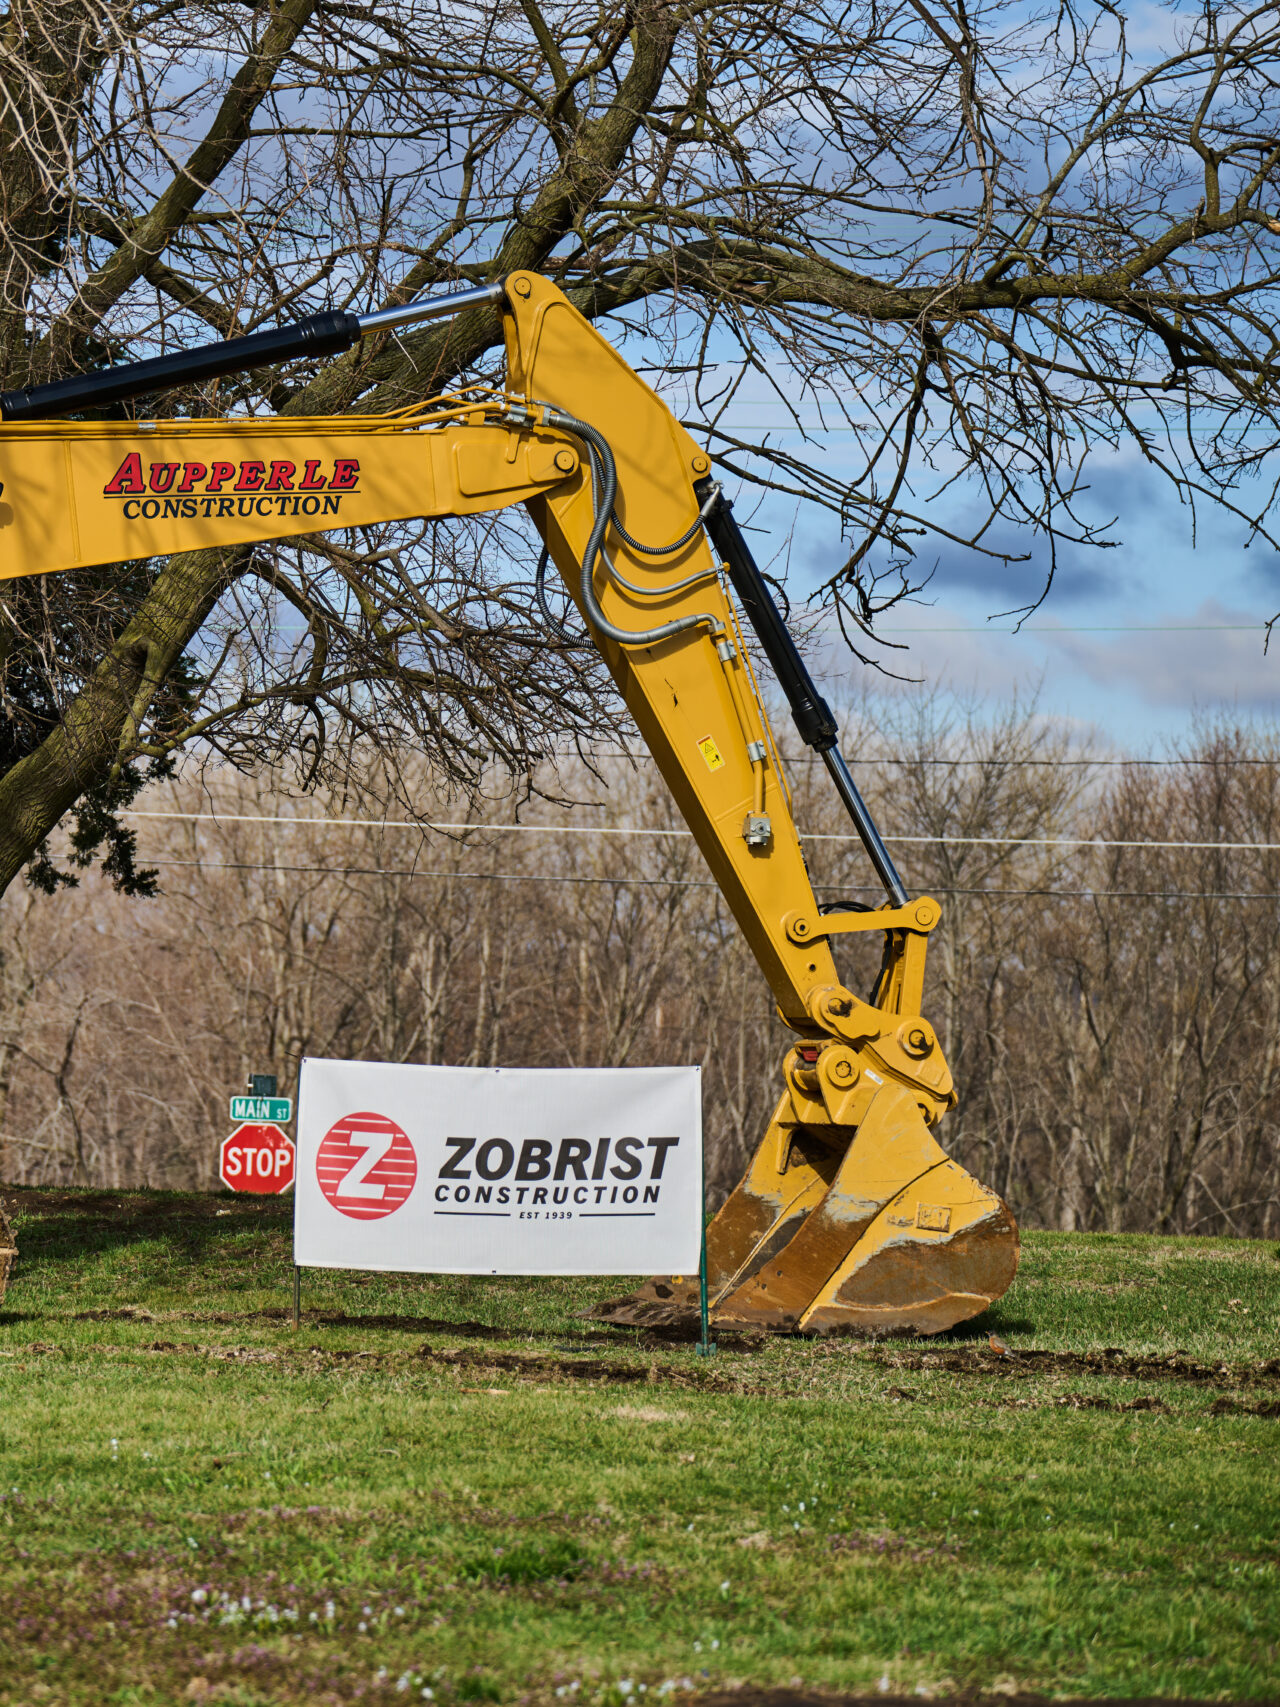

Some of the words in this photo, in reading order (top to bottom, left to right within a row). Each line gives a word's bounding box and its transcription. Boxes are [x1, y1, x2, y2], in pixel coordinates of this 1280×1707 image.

[103, 452, 361, 494] AUPPERLE
[123, 496, 342, 520] CONSTRUCTION
[235, 1100, 270, 1118] MAIN
[277, 1108, 287, 1119] ST
[226, 1146, 291, 1177] STOP
[335, 1130, 394, 1200] Z
[438, 1136, 680, 1181] ZOBRIST
[434, 1184, 660, 1205] CONSTRUCTION
[519, 1211, 540, 1219] EST
[545, 1211, 572, 1219] 1939
